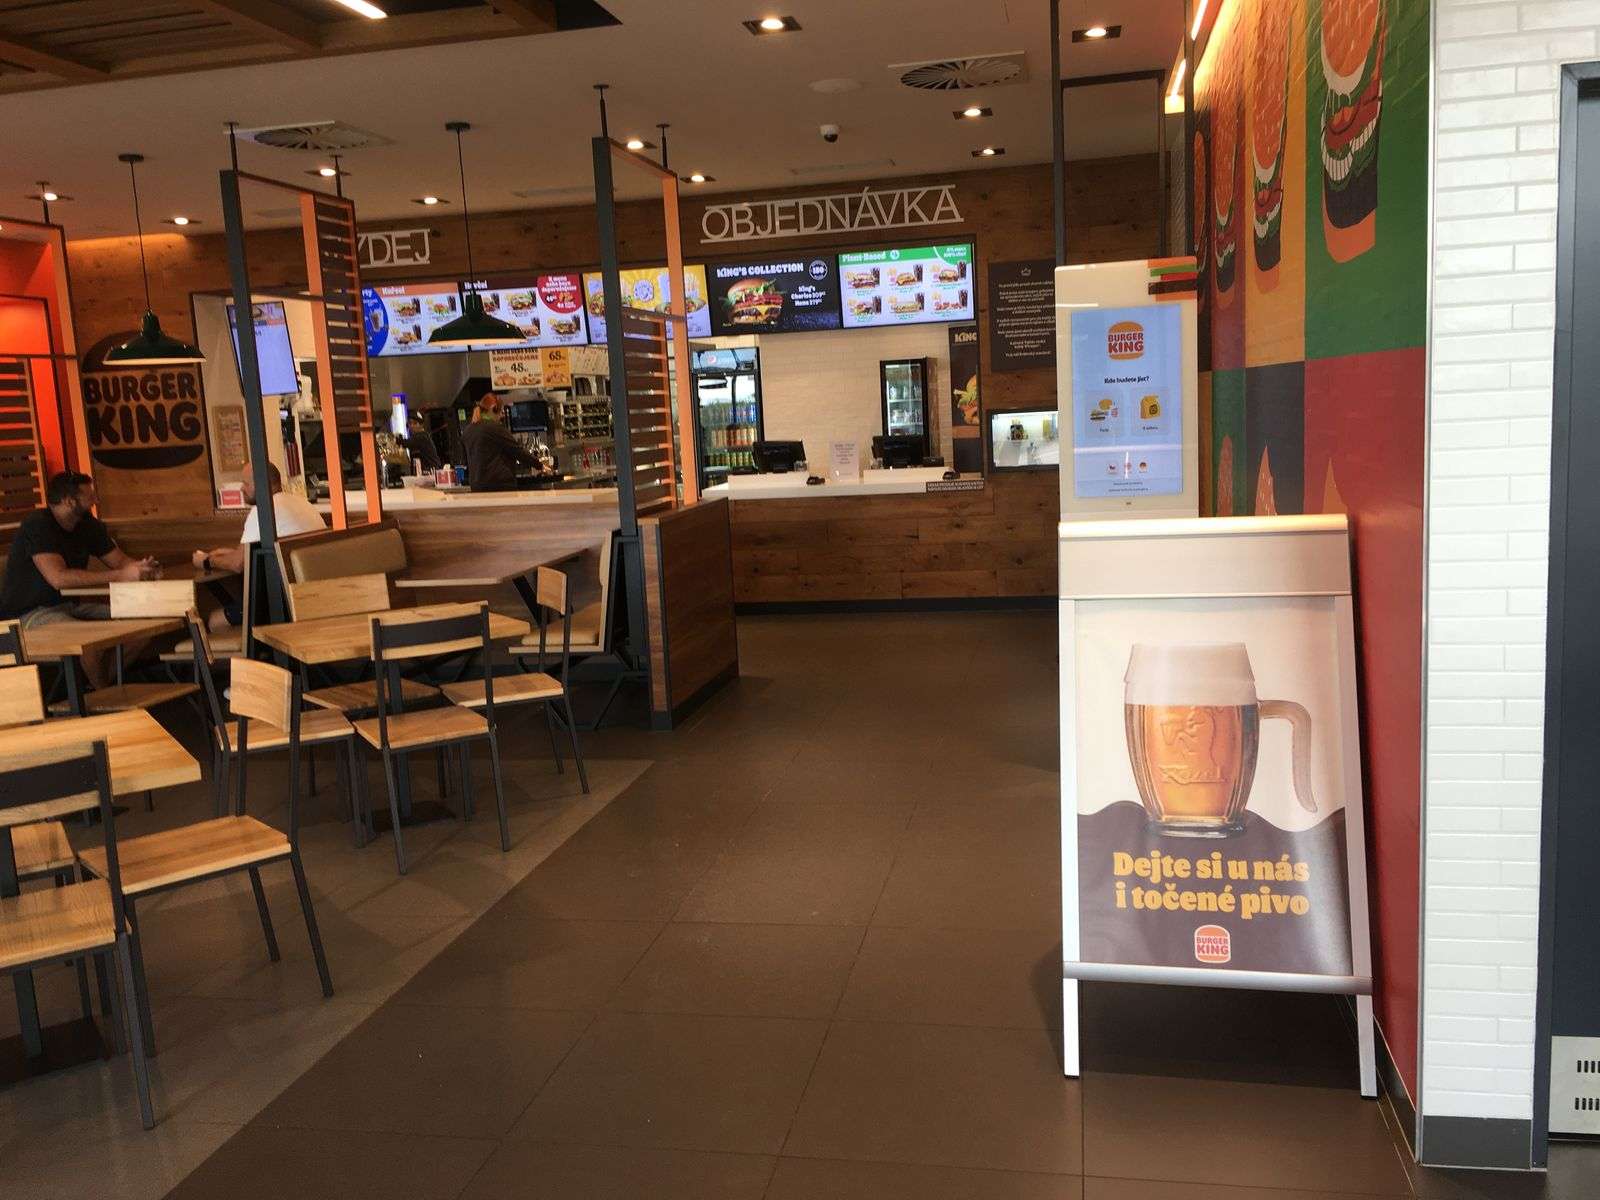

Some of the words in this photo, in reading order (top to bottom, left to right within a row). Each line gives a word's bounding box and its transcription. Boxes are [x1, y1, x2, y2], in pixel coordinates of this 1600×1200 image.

[701, 186, 963, 242] OBJEDNÁVKA
[748, 262, 804, 276] COLLECTION
[1107, 332, 1144, 342] BURGER
[1107, 341, 1144, 353] KING
[83, 372, 198, 405] BURGER
[87, 401, 201, 447] KING
[1113, 850, 1191, 884] Dejte
[1196, 851, 1223, 879] si
[1227, 859, 1249, 880] u
[1252, 854, 1310, 882] nás
[1115, 881, 1127, 908] i
[1132, 883, 1236, 913] točené
[1240, 886, 1310, 919] pivo
[1196, 936, 1229, 945] BURGER
[1196, 944, 1229, 956] KING
